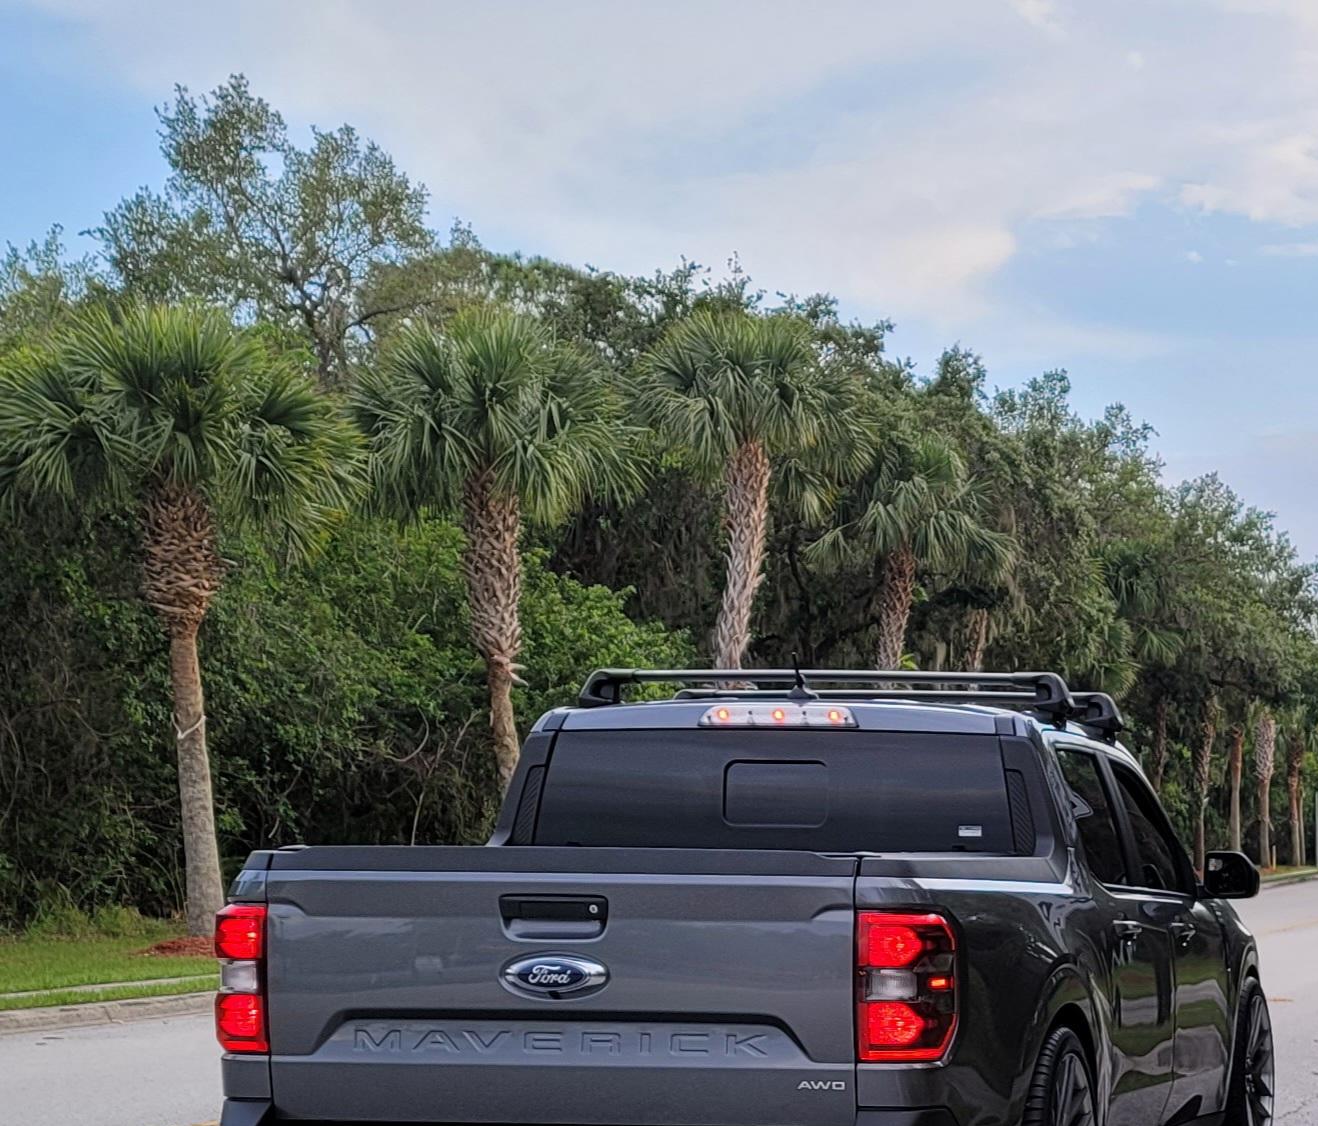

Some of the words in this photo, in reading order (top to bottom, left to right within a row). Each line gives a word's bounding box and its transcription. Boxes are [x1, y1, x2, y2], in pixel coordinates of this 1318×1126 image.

[528, 965, 572, 984] Ford
[352, 1029, 769, 1057] MAVERICK
[797, 1080, 846, 1090] AWD
